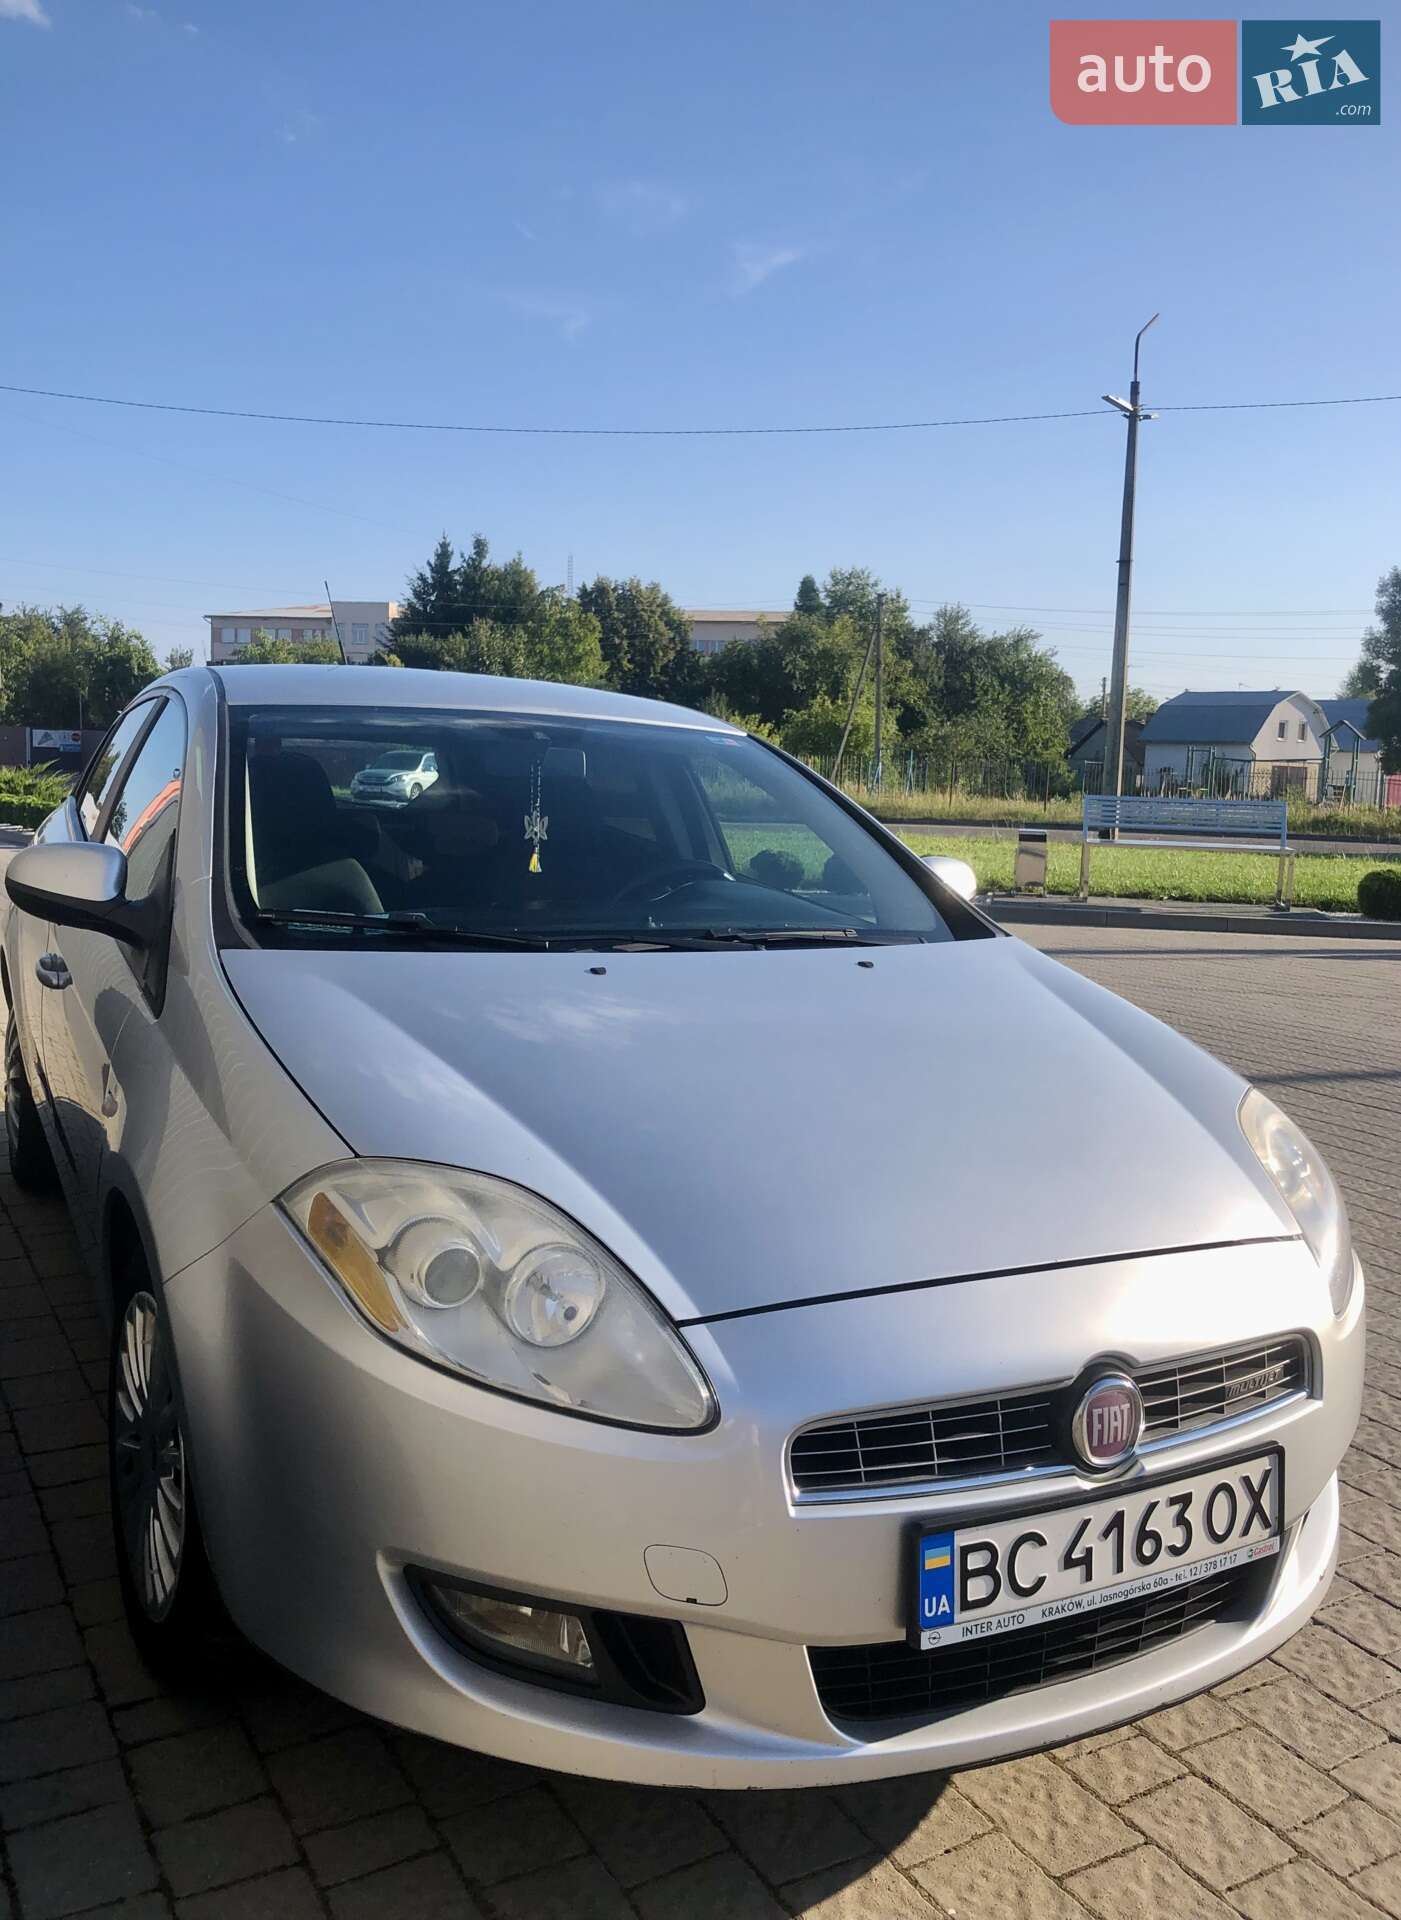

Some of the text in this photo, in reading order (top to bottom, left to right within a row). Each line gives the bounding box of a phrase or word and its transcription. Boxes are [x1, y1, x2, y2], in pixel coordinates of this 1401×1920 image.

[1092, 1404, 1131, 1447] FIAT
[1063, 1493, 1193, 1583] 4163
[924, 1594, 951, 1617] UA
[961, 1621, 993, 1638] INTER
[995, 1613, 1025, 1630] AUTO
[1087, 1595, 1097, 1606] ul.
